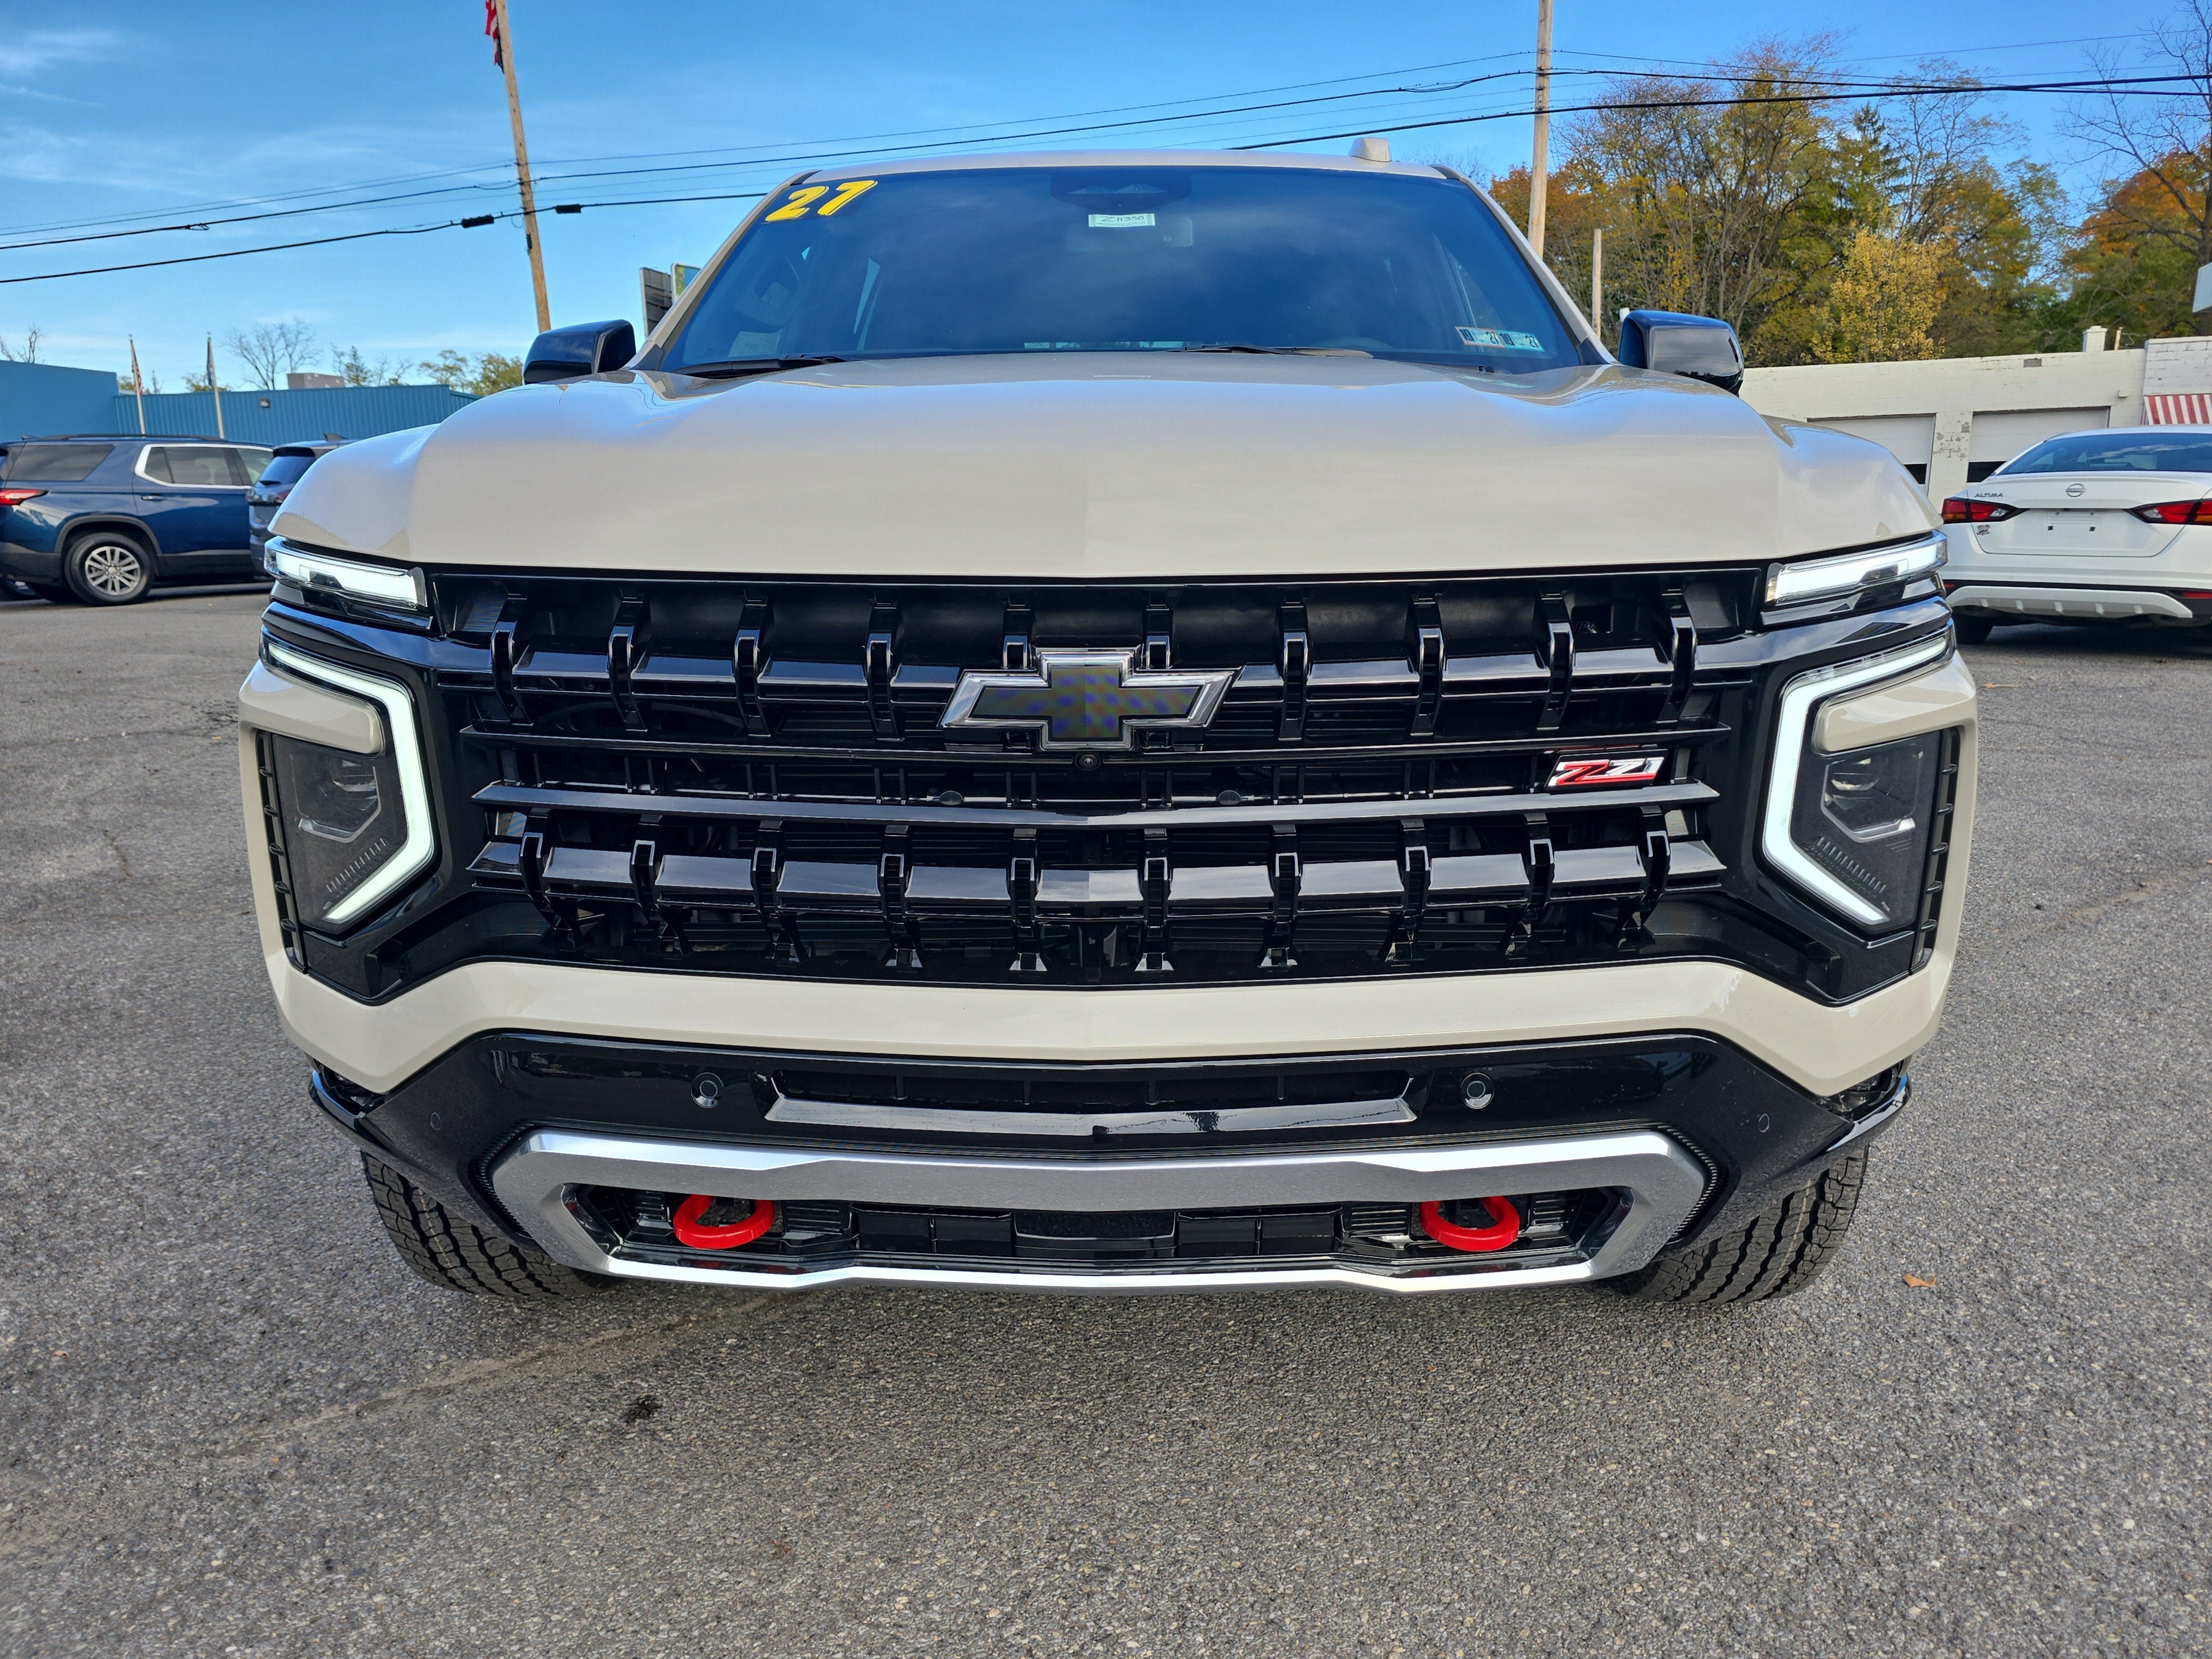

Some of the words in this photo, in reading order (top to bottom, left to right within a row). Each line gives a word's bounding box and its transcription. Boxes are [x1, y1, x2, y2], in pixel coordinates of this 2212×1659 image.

[1459, 329, 1475, 342] 10
[1499, 333, 1515, 346] 10
[1548, 757, 1664, 787] Z71
